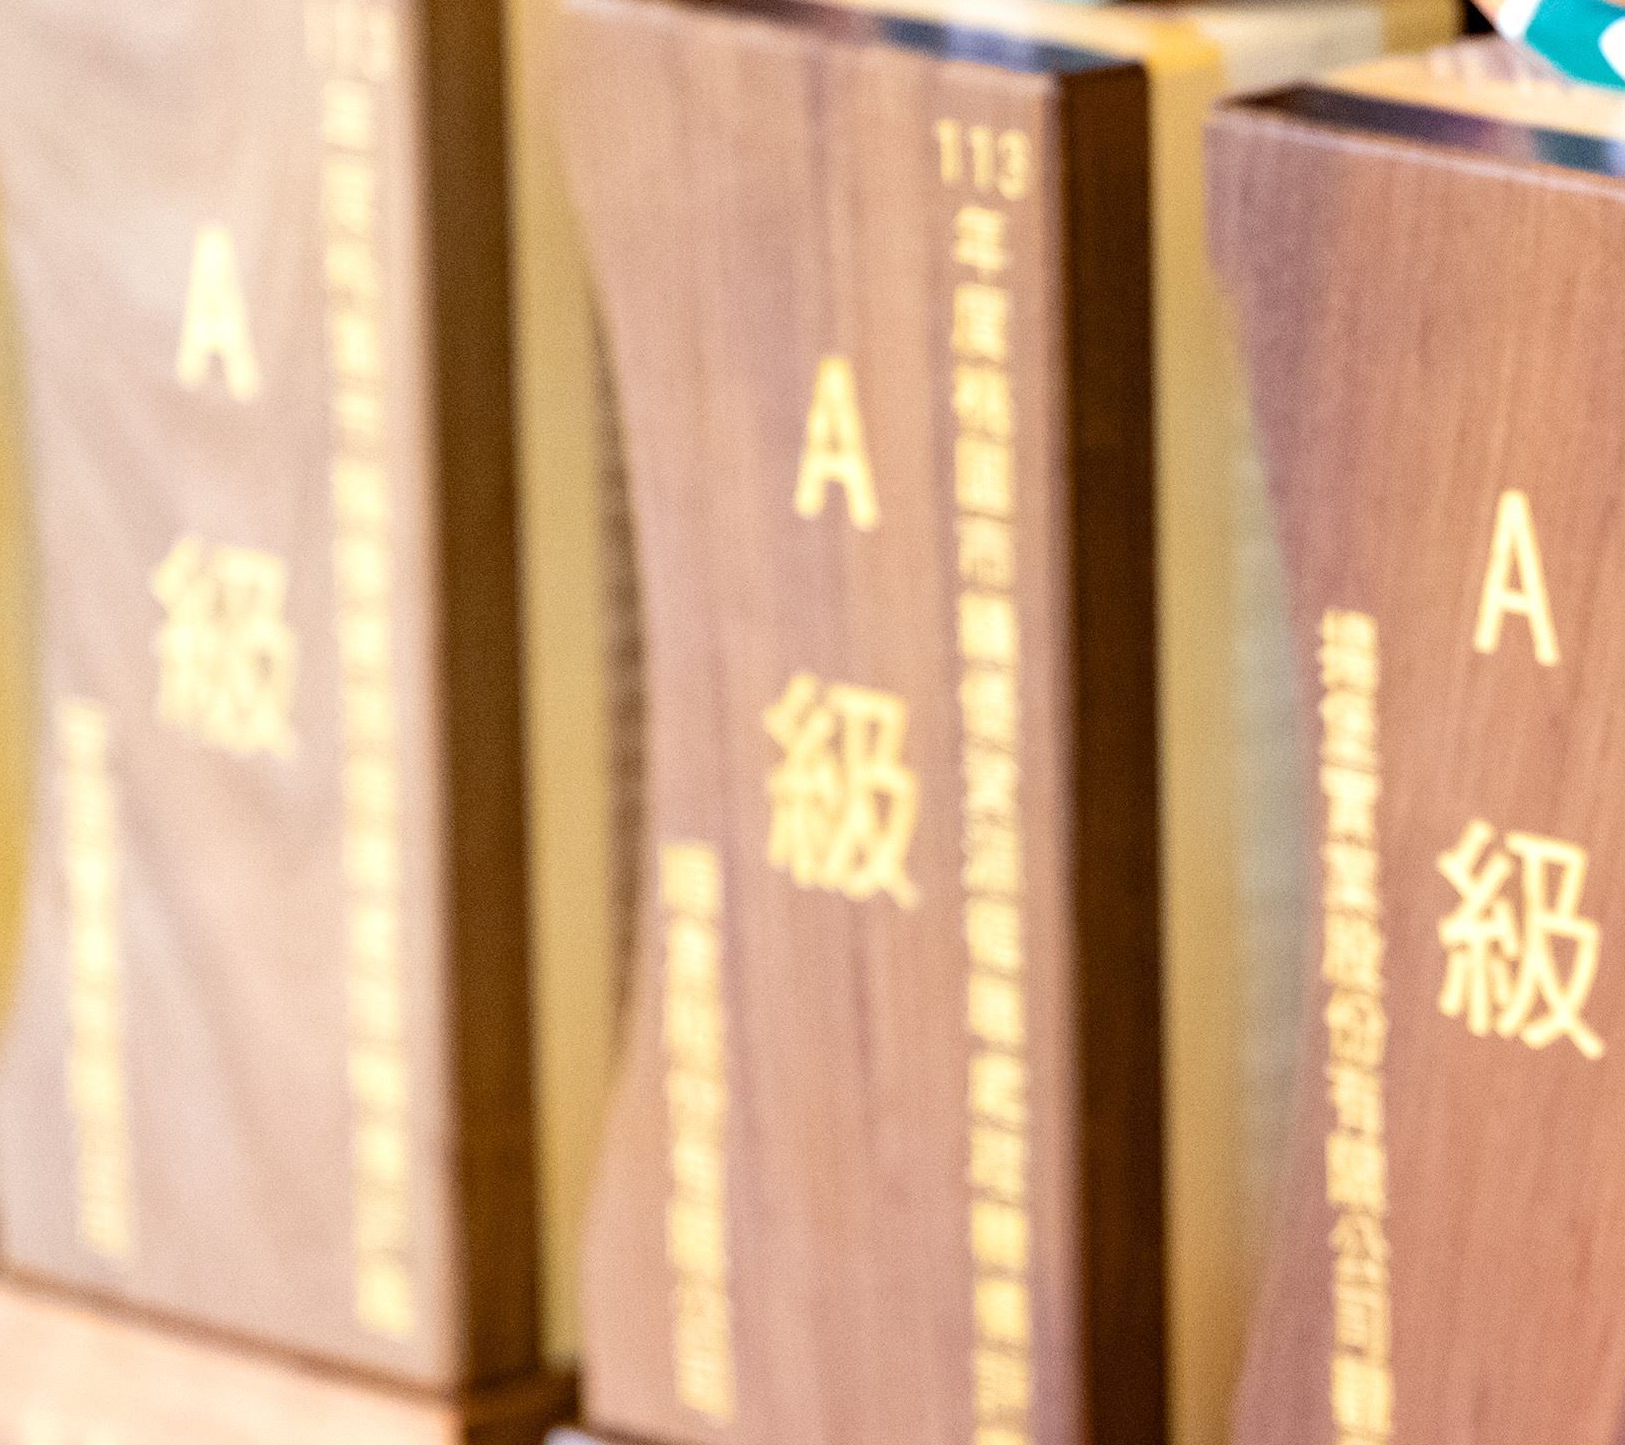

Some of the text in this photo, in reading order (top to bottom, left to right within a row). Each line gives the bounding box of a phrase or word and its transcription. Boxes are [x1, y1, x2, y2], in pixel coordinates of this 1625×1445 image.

[795, 356, 880, 530] A
[1437, 488, 1604, 1059] A 級
